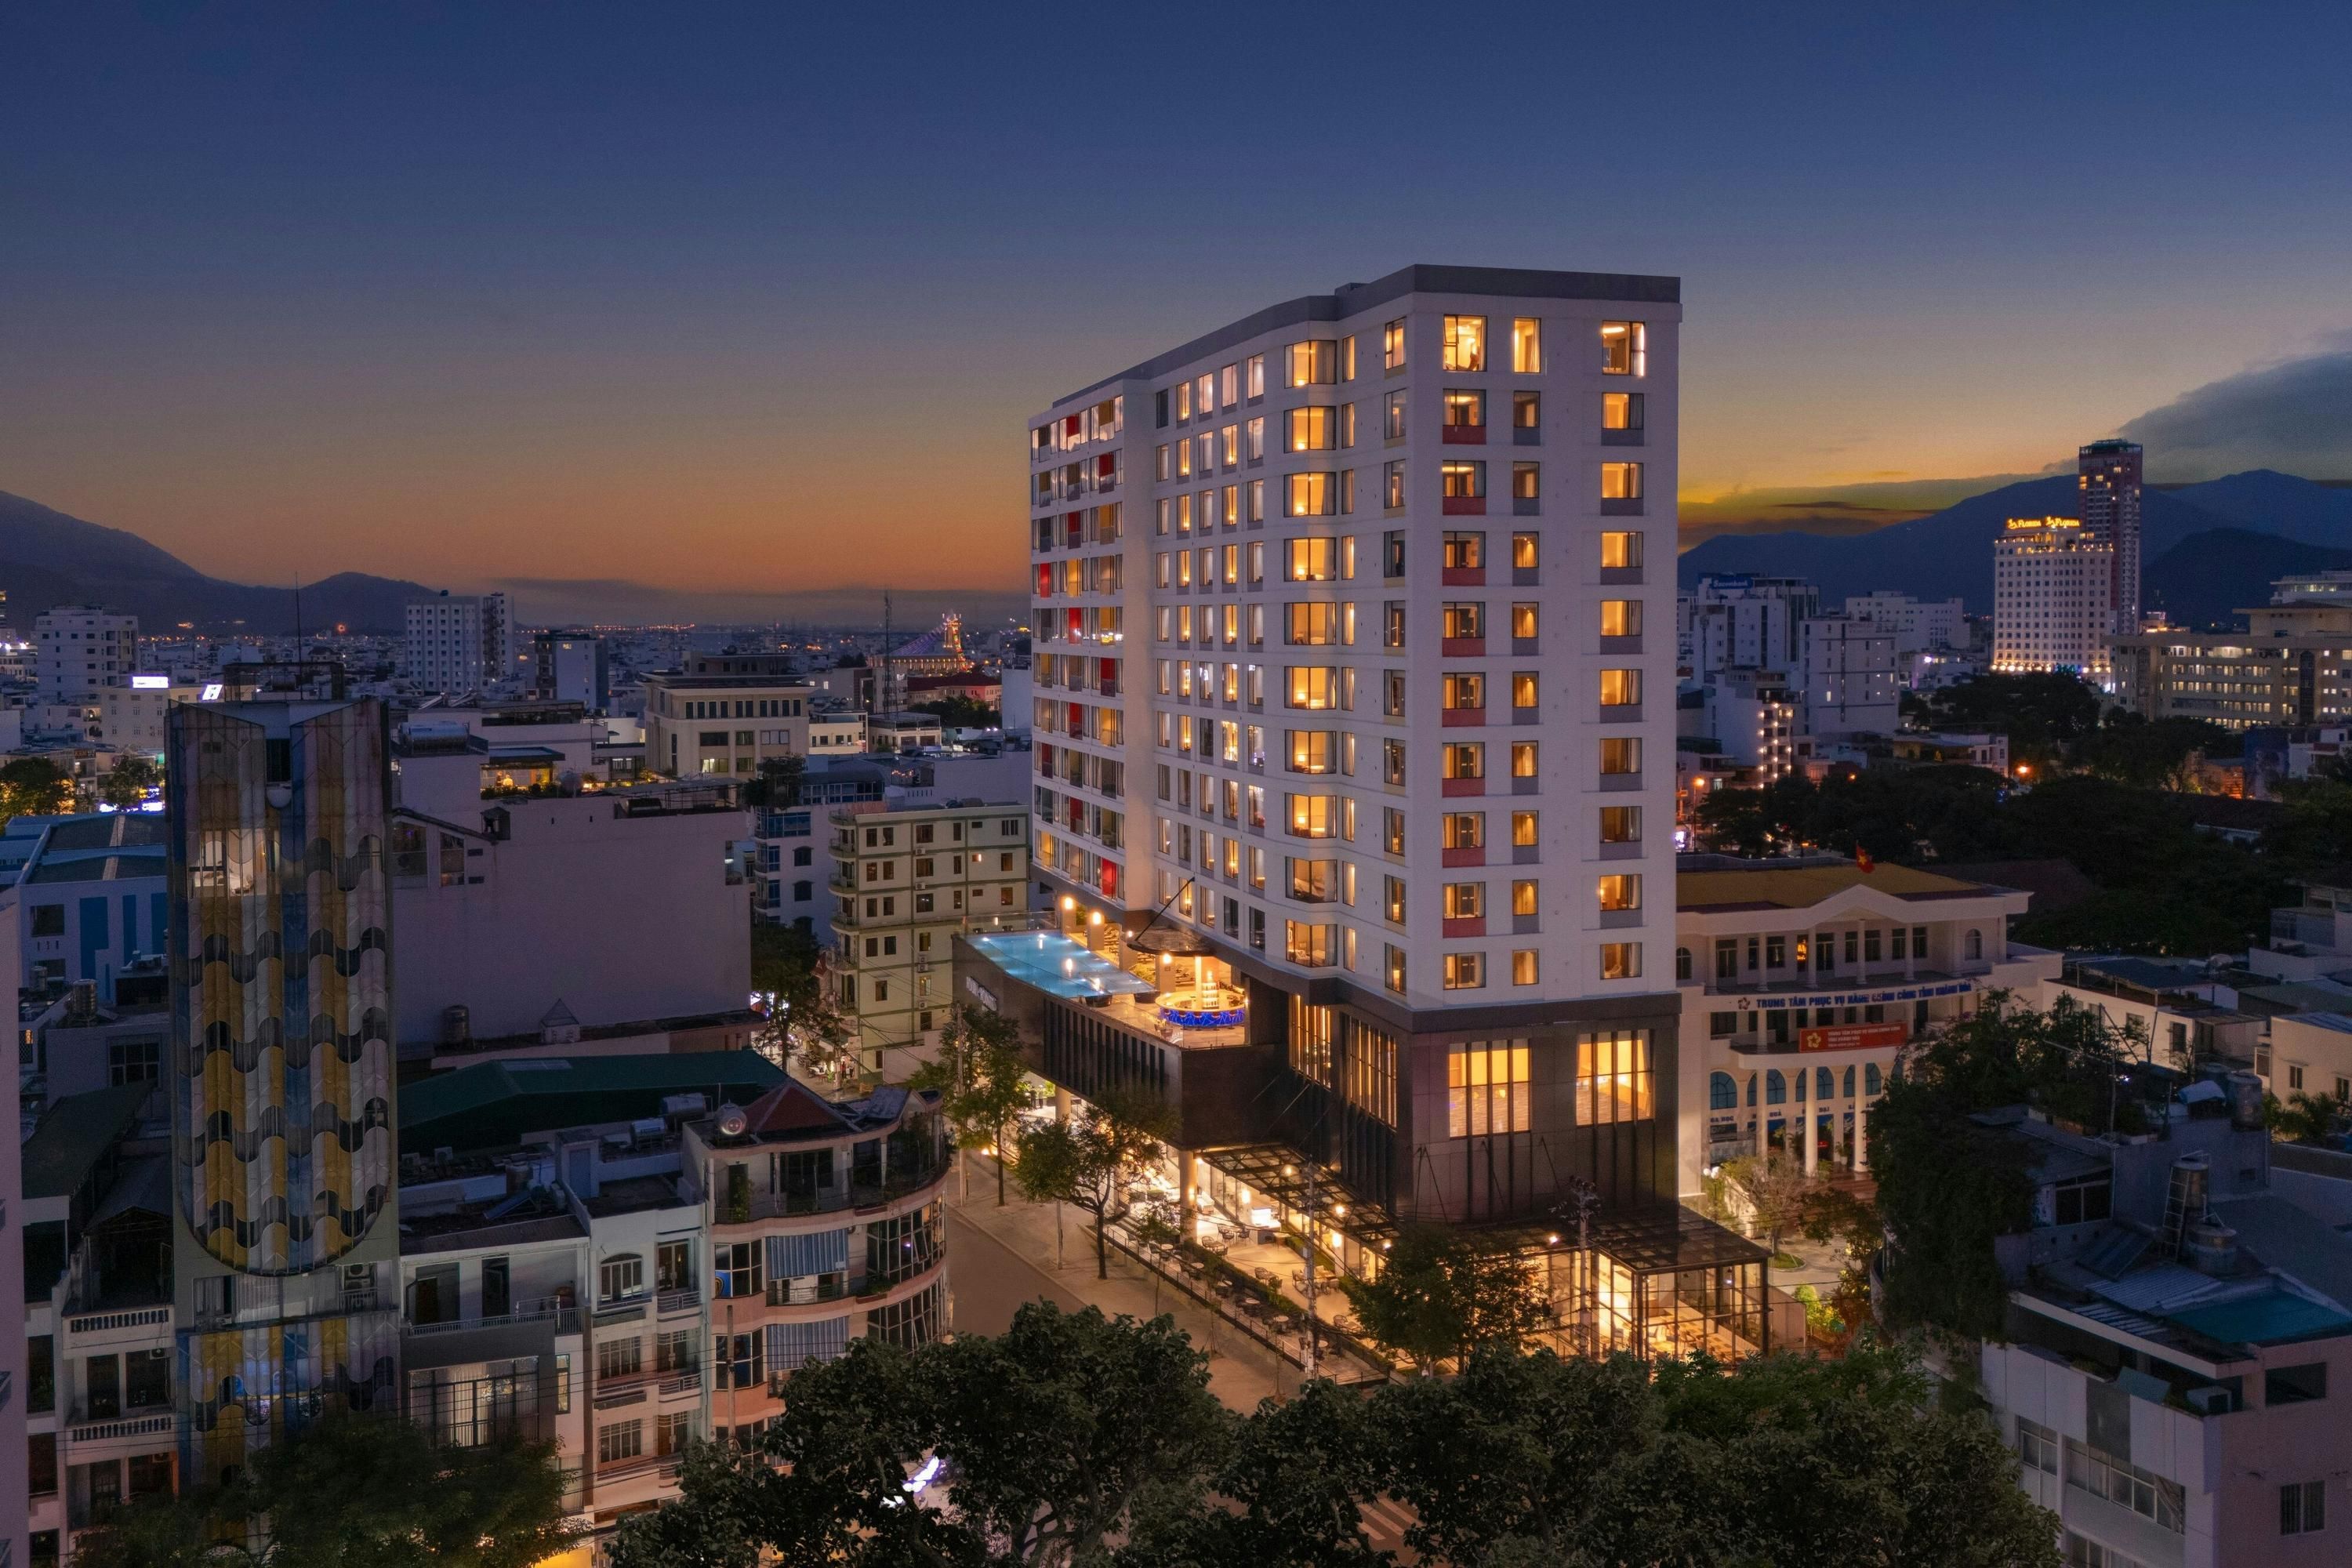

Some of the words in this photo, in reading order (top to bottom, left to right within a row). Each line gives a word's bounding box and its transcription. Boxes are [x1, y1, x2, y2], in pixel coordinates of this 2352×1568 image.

[1756, 998, 1786, 1008] TRUNG
[1788, 996, 1807, 1007] TÂM
[1809, 996, 1831, 1007] PHỤC
